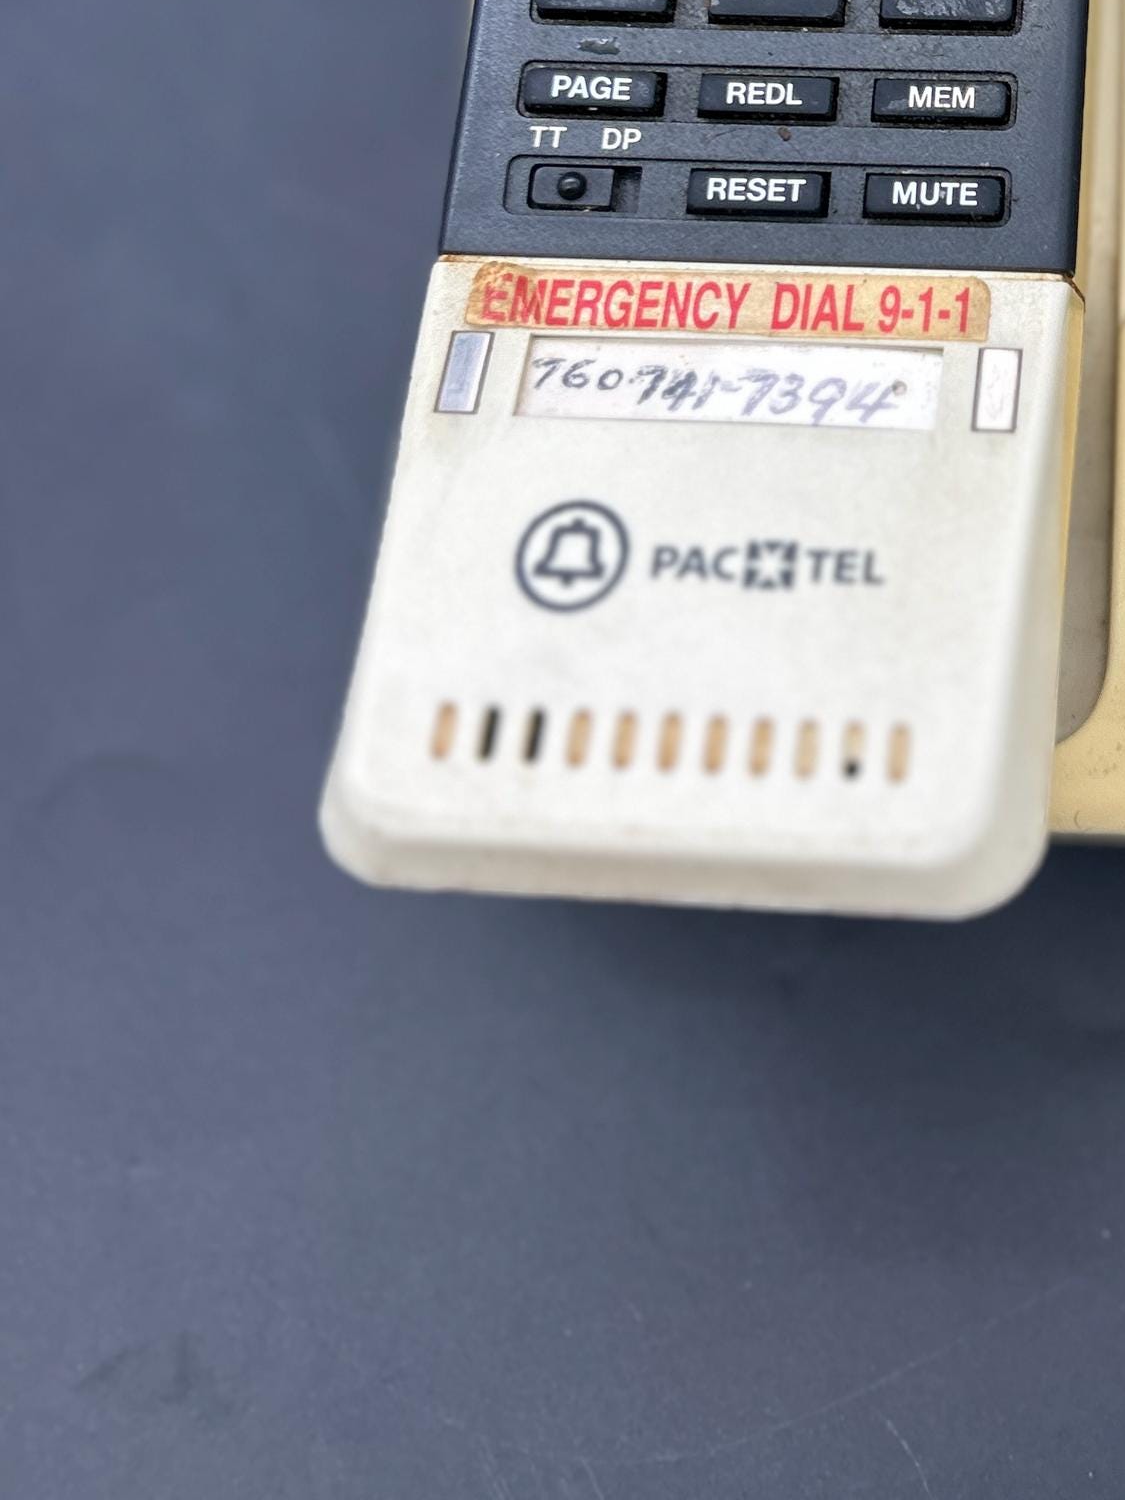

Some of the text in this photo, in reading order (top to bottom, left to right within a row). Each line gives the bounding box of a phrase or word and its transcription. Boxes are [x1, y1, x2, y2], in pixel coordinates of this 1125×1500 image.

[550, 75, 632, 101] PAGE
[725, 81, 803, 107] REDL
[908, 86, 976, 109] MEM
[529, 126, 642, 151] TT DP
[706, 177, 807, 203] RESET
[891, 181, 978, 206] MUTE
[481, 273, 971, 334] EMERGENCY DIAL 9-1-1
[807, 550, 885, 586] TEL
